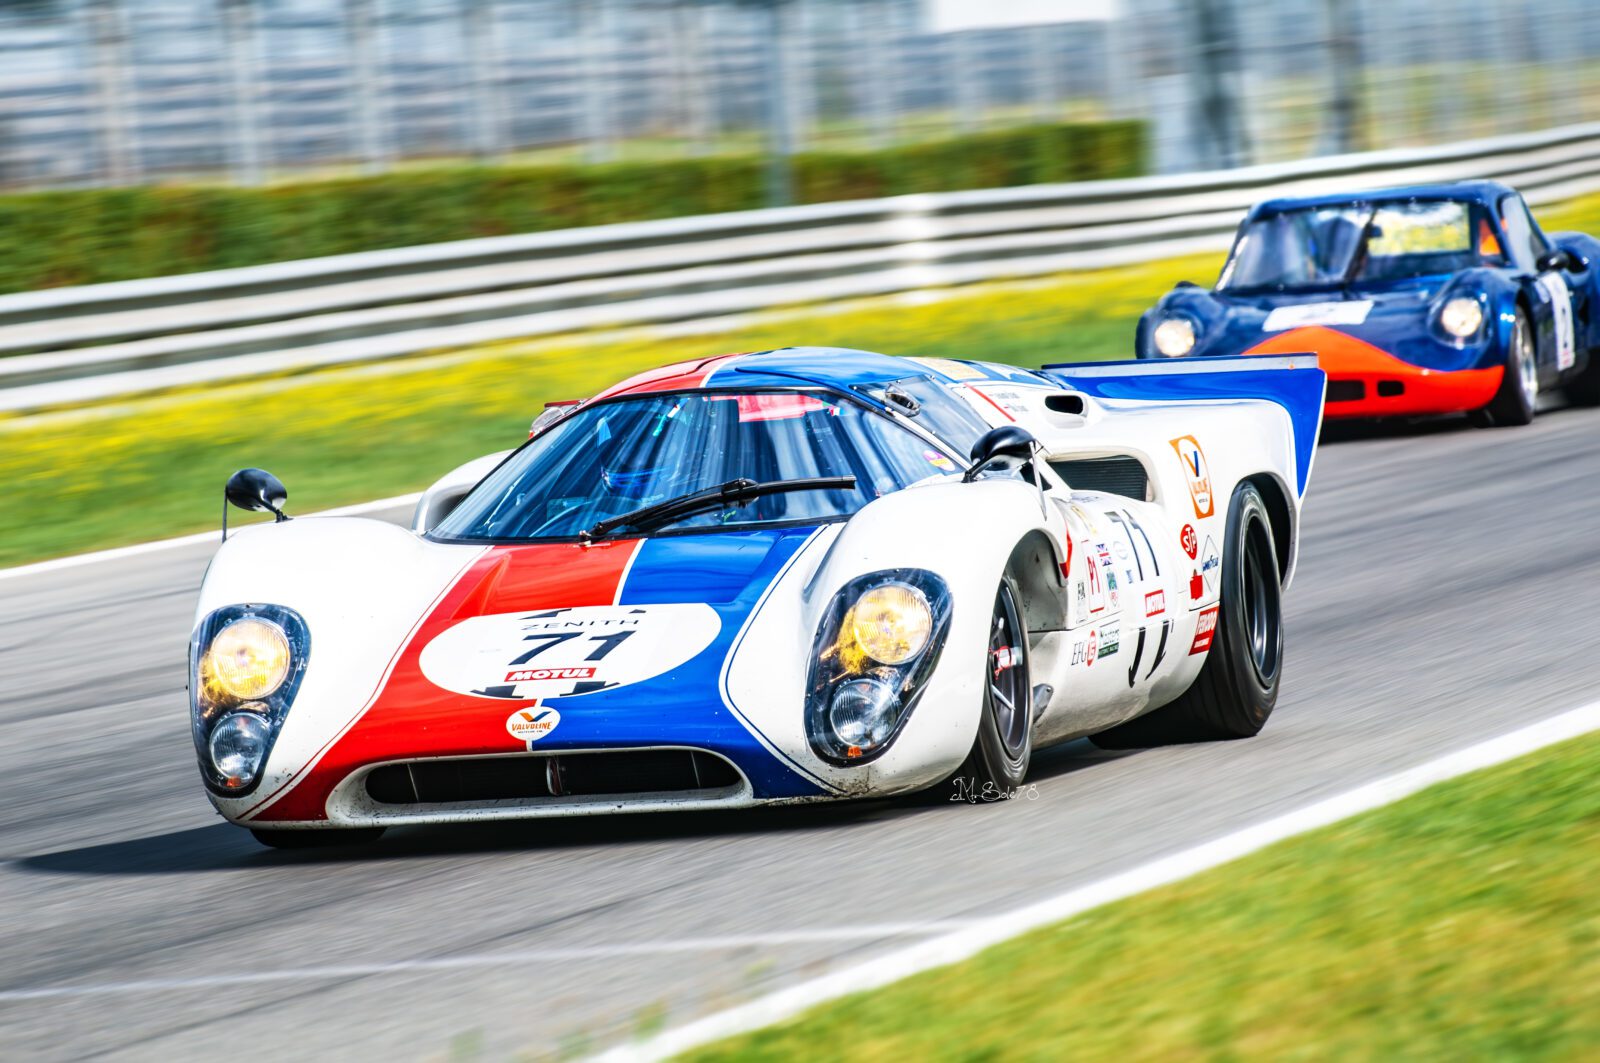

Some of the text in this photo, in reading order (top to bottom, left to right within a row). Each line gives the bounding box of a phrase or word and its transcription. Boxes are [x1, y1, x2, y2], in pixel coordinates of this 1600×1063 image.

[1183, 526, 1197, 554] STP
[521, 619, 639, 631] ZENITH
[508, 630, 637, 666] 71
[508, 667, 592, 682] MOTUL
[511, 721, 553, 732] VALVOLINE
